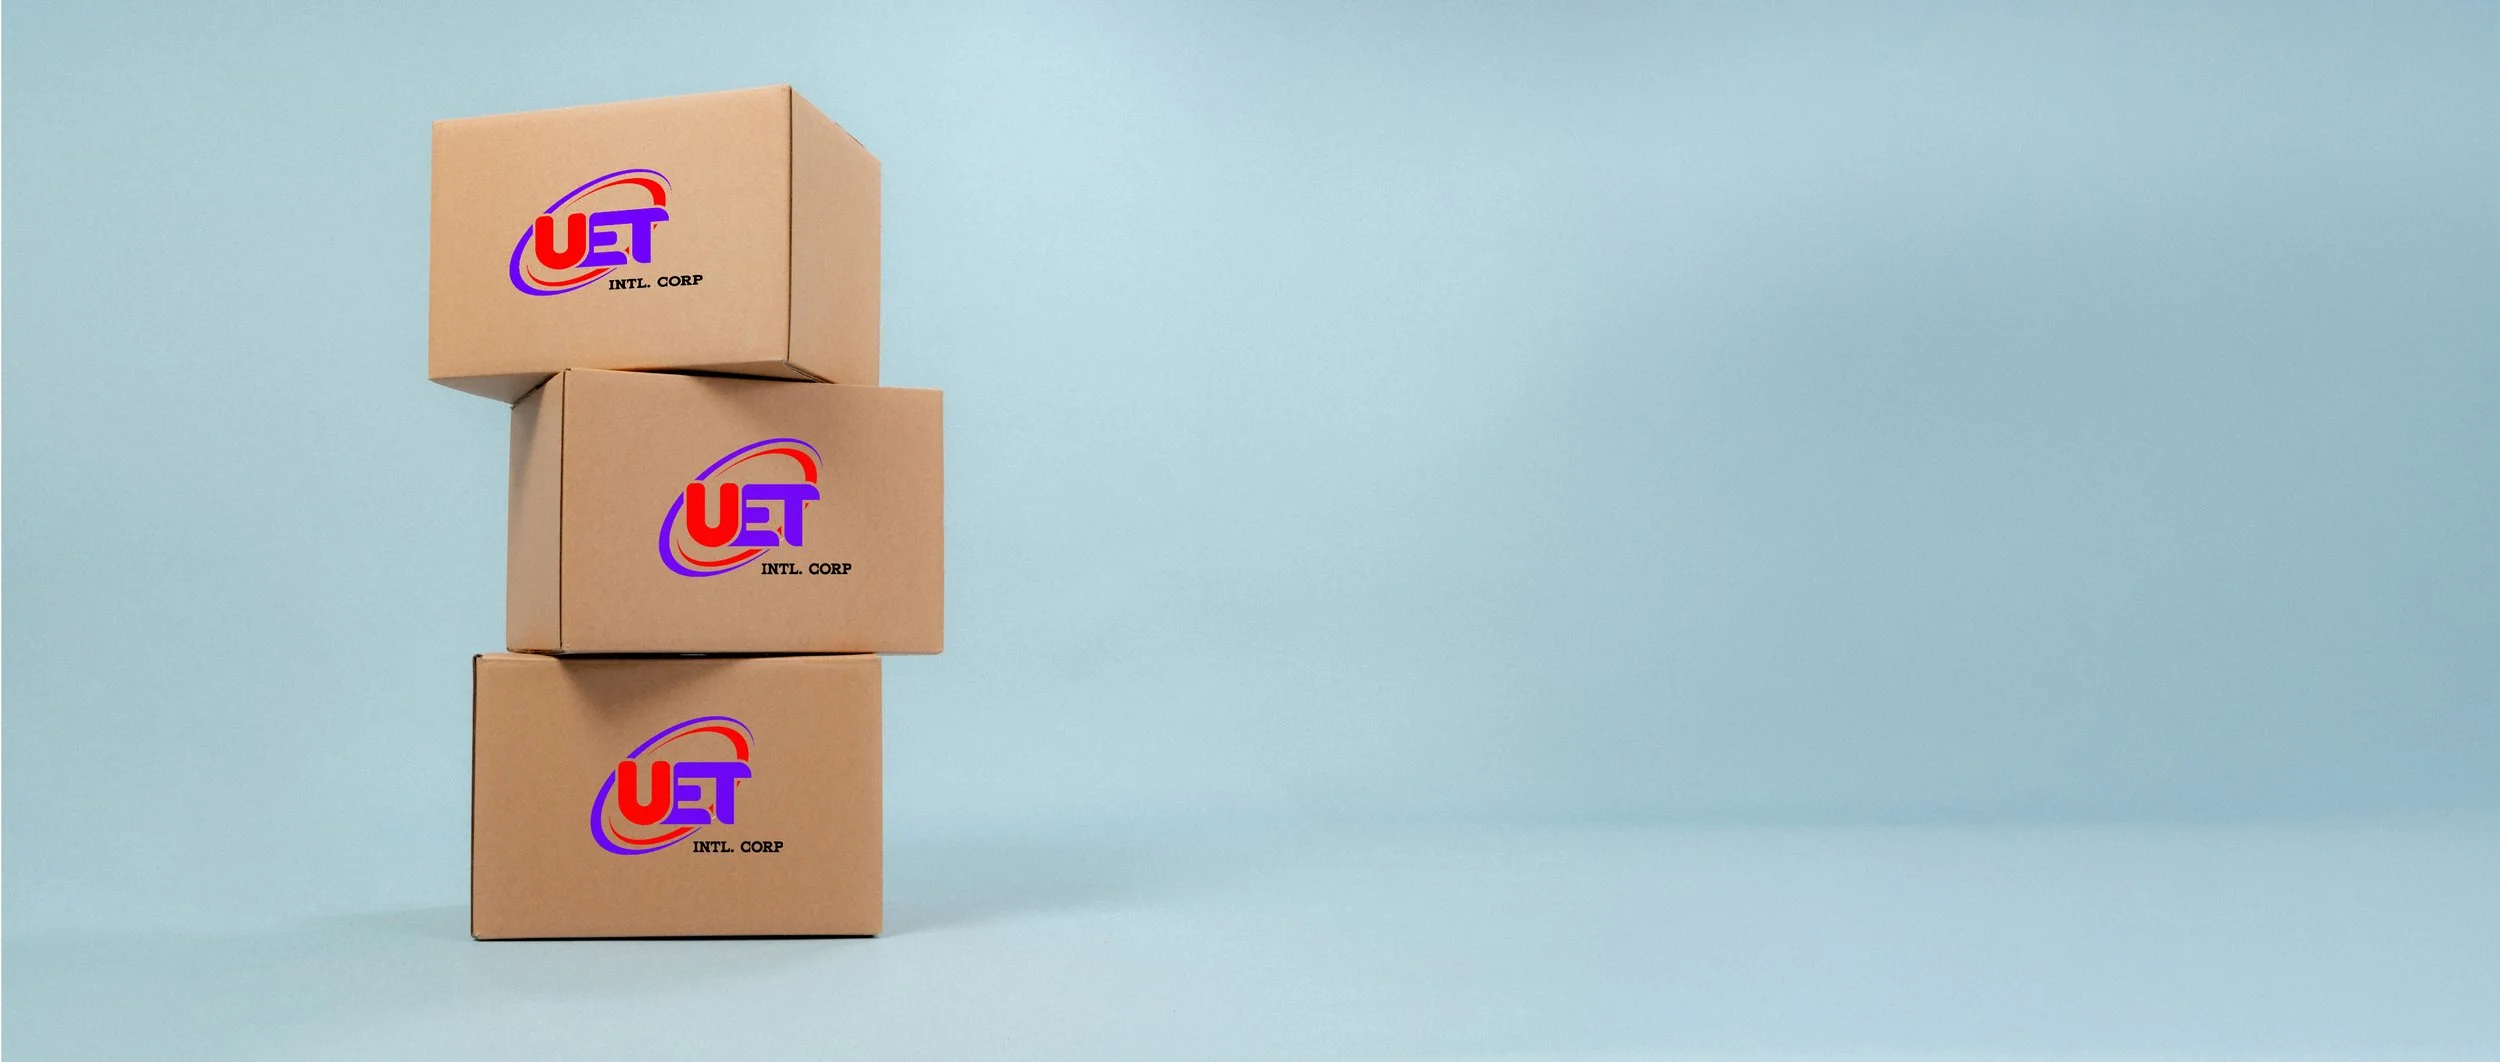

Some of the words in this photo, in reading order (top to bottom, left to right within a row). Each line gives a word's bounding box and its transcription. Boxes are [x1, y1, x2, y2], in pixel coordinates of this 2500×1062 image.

[534, 207, 670, 270] UET
[608, 277, 651, 290] INTL.
[657, 274, 704, 288] CORP
[686, 483, 821, 548] UET
[761, 562, 803, 575] INTL.
[808, 562, 852, 575] CORP
[617, 760, 752, 826] UET
[692, 840, 735, 853] INTL.
[740, 840, 784, 853] CORP
